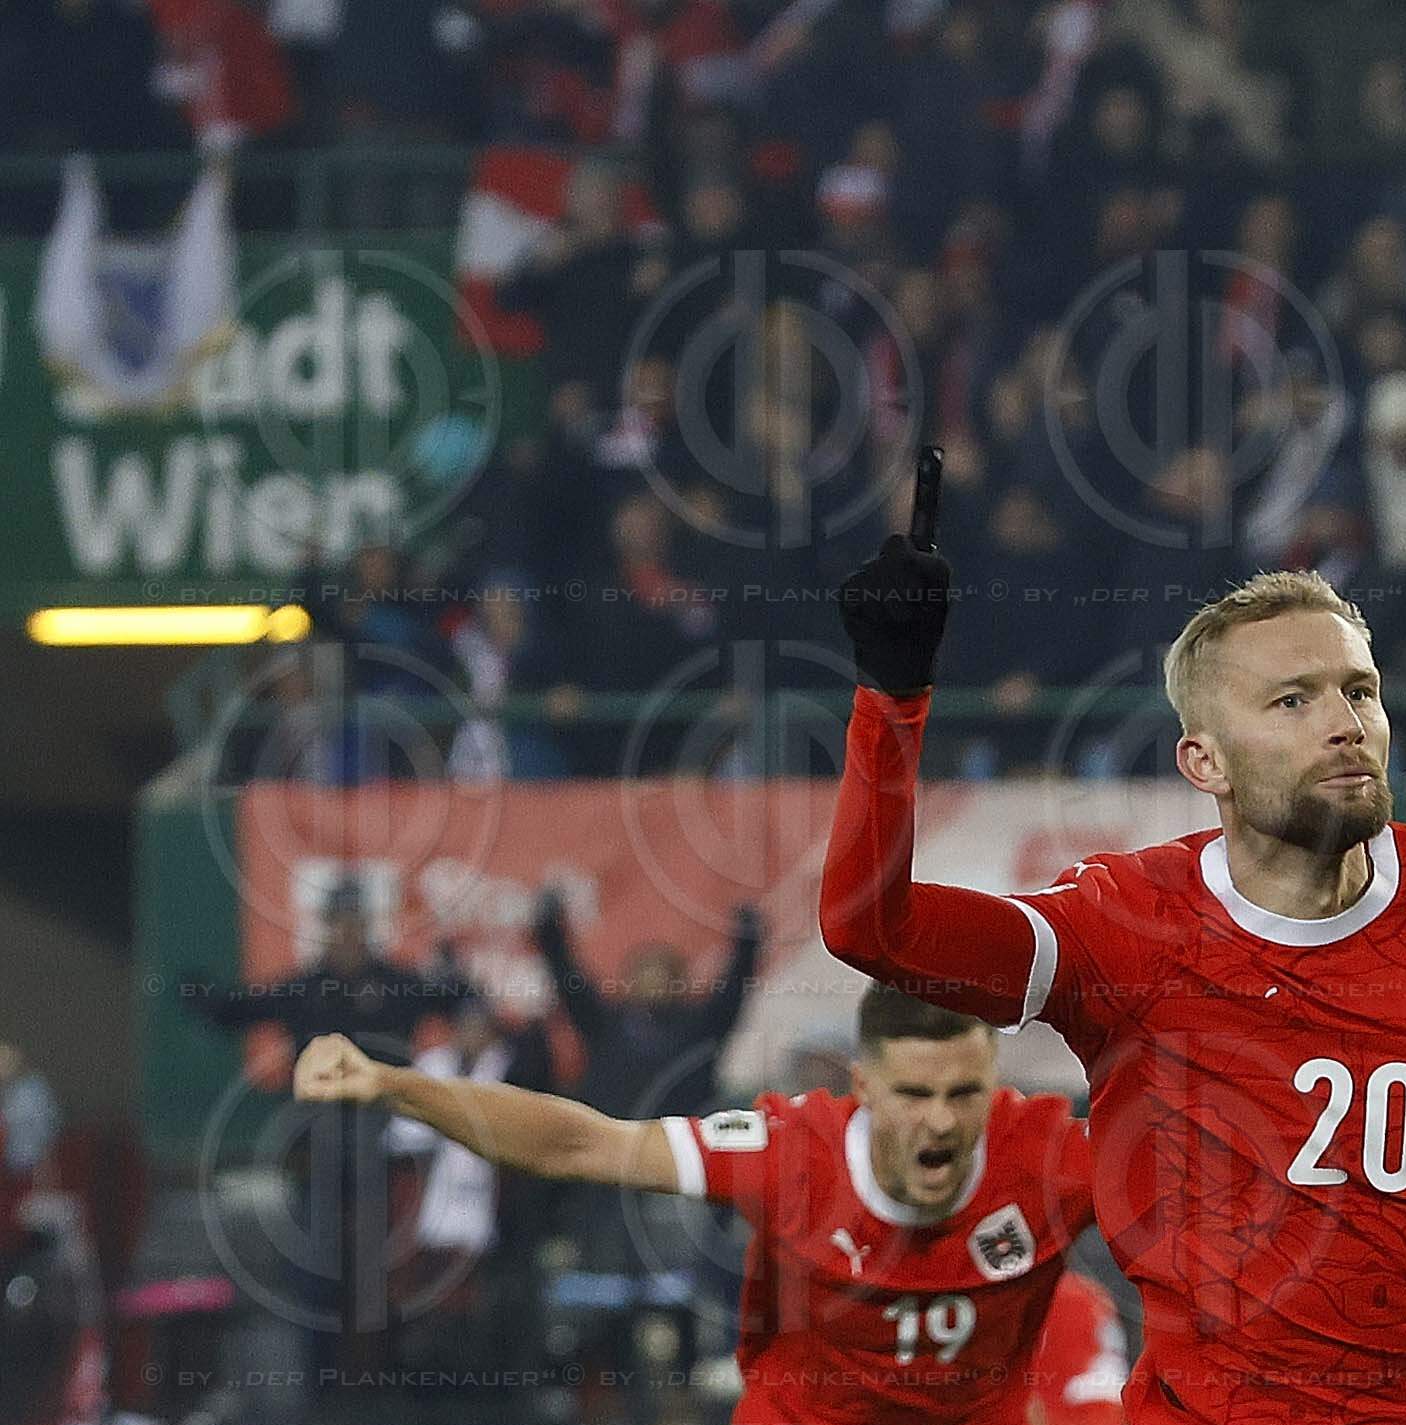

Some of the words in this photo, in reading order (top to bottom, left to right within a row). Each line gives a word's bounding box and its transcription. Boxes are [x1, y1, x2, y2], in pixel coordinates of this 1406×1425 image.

[55, 278, 404, 424] adt
[52, 435, 403, 576] Wien
[882, 1294, 978, 1367] 19
